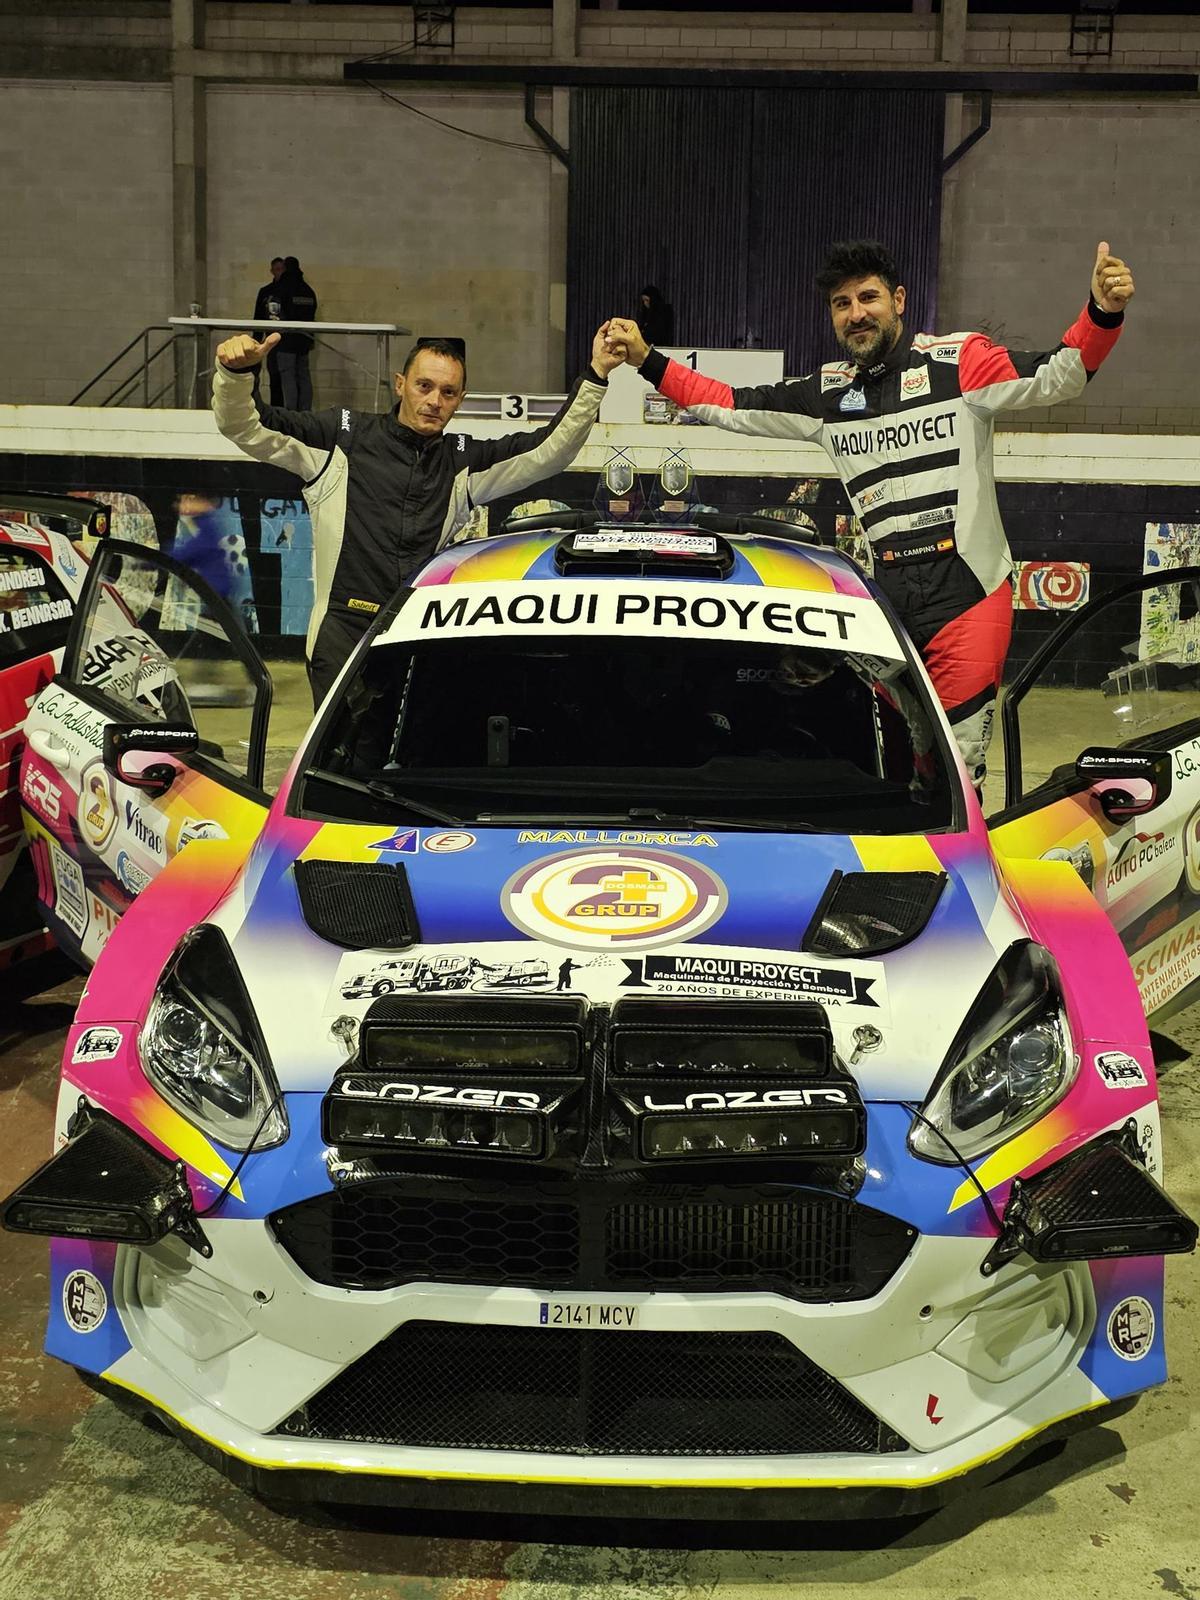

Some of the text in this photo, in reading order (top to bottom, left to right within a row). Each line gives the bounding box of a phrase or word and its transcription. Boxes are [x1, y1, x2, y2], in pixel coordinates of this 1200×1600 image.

[687, 351, 697, 370] 1
[937, 348, 957, 357] OMP
[505, 395, 524, 418] 3
[877, 412, 957, 451] PROYECT
[904, 544, 936, 557] CAMPINS
[11, 599, 73, 630] BENNASAR
[420, 594, 856, 640] MAQUI PROYECT
[143, 730, 196, 738] M-SPORT
[125, 800, 163, 854] Vitrac
[518, 830, 719, 847] MALLORCA
[1107, 855, 1137, 888] AUTO
[1139, 844, 1153, 868] PC
[1154, 837, 1176, 859] balear
[574, 904, 657, 916] GRUP
[1135, 926, 1200, 986] SCINA
[653, 971, 713, 982] Maquinaria
[717, 975, 730, 983] de
[733, 976, 790, 989] Proyección
[802, 983, 847, 995] Bombeo
[675, 958, 822, 984] MAQUI PROYECT
[1141, 944, 1200, 1000] ANTENIMIENTOS
[657, 984, 842, 1007] 20 AÑOS DE EXPERIENCIA
[1144, 976, 1183, 1014] ALLORCA
[553, 1305, 591, 1324] 2141
[600, 1306, 635, 1325] MCV
